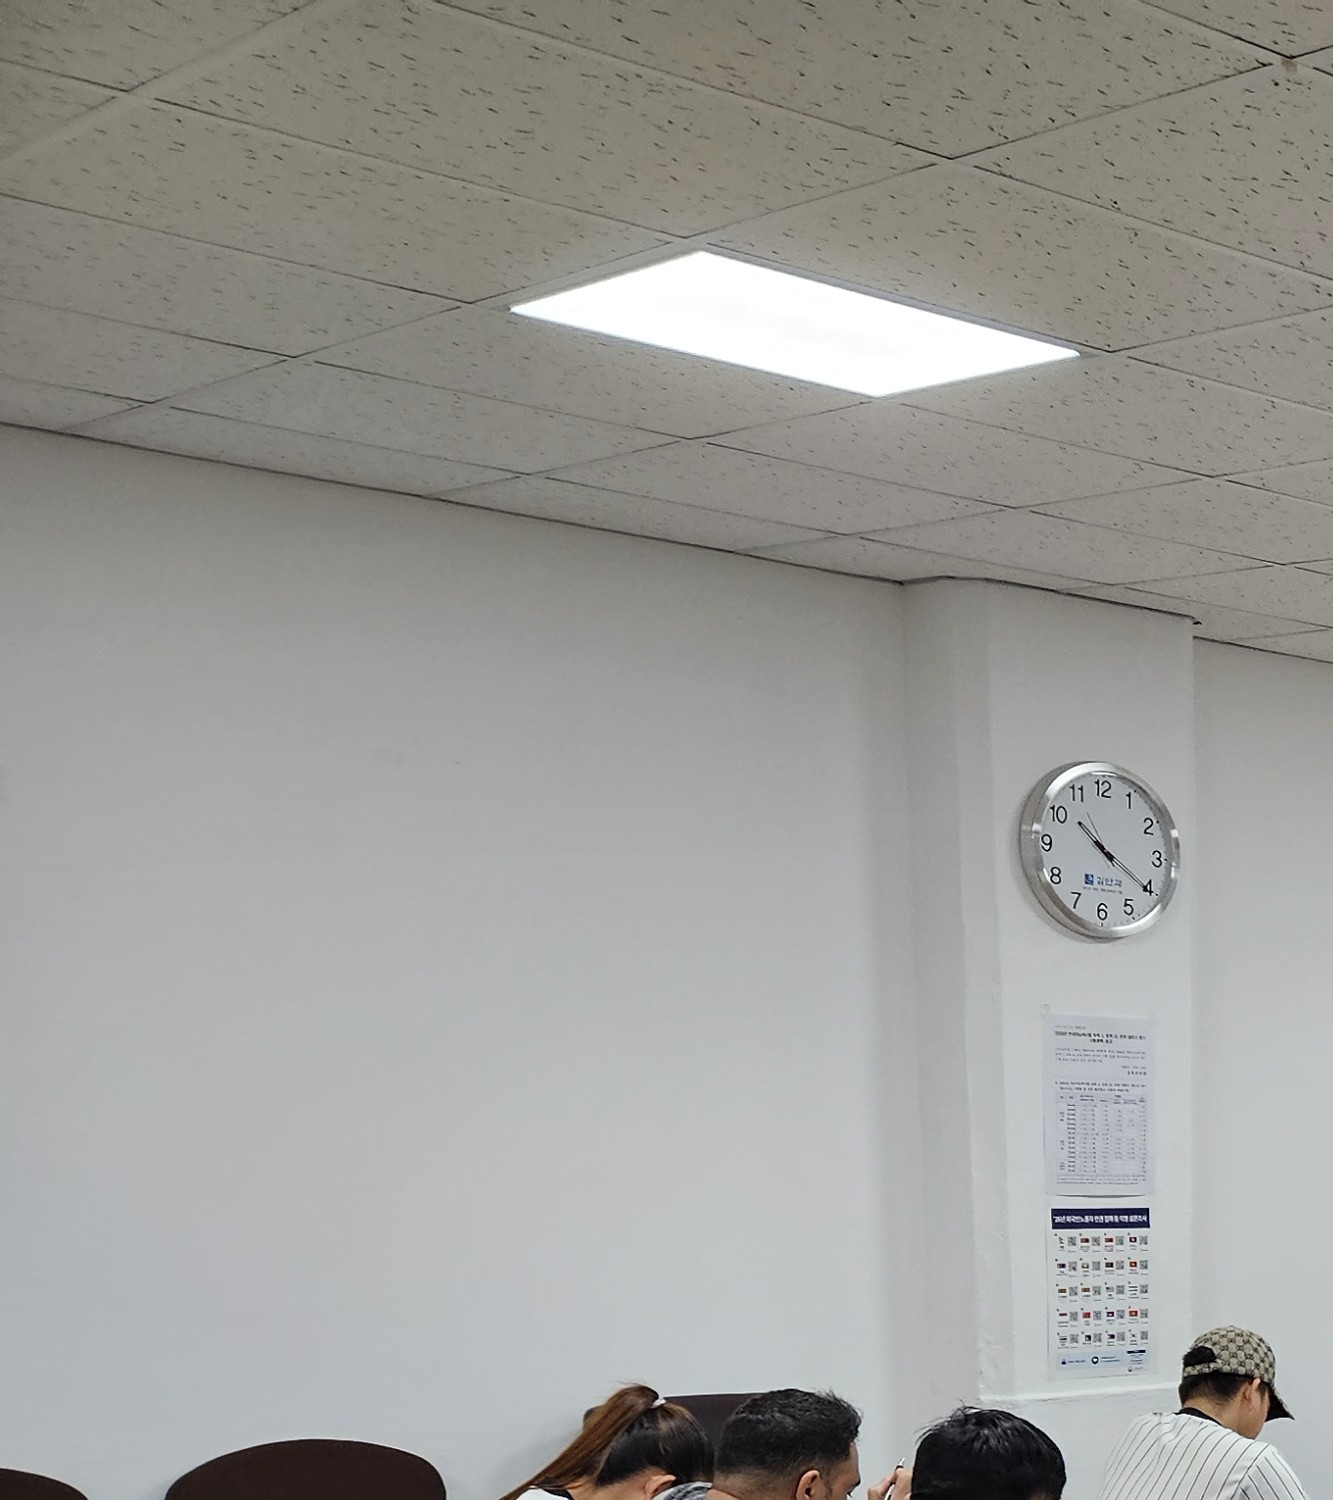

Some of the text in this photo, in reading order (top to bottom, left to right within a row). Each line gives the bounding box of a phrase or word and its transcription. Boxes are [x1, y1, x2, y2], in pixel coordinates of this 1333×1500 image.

[1069, 784, 1084, 803] 11
[1094, 779, 1112, 798] 12
[1125, 792, 1132, 809] 1
[1050, 804, 1068, 824] 10
[1143, 817, 1154, 836] 2
[1041, 833, 1053, 852] 9
[1151, 850, 1162, 868] 3
[1050, 866, 1061, 885] 8
[1070, 891, 1082, 909] 7
[1123, 899, 1134, 916] 5
[1097, 903, 1108, 921] 6
